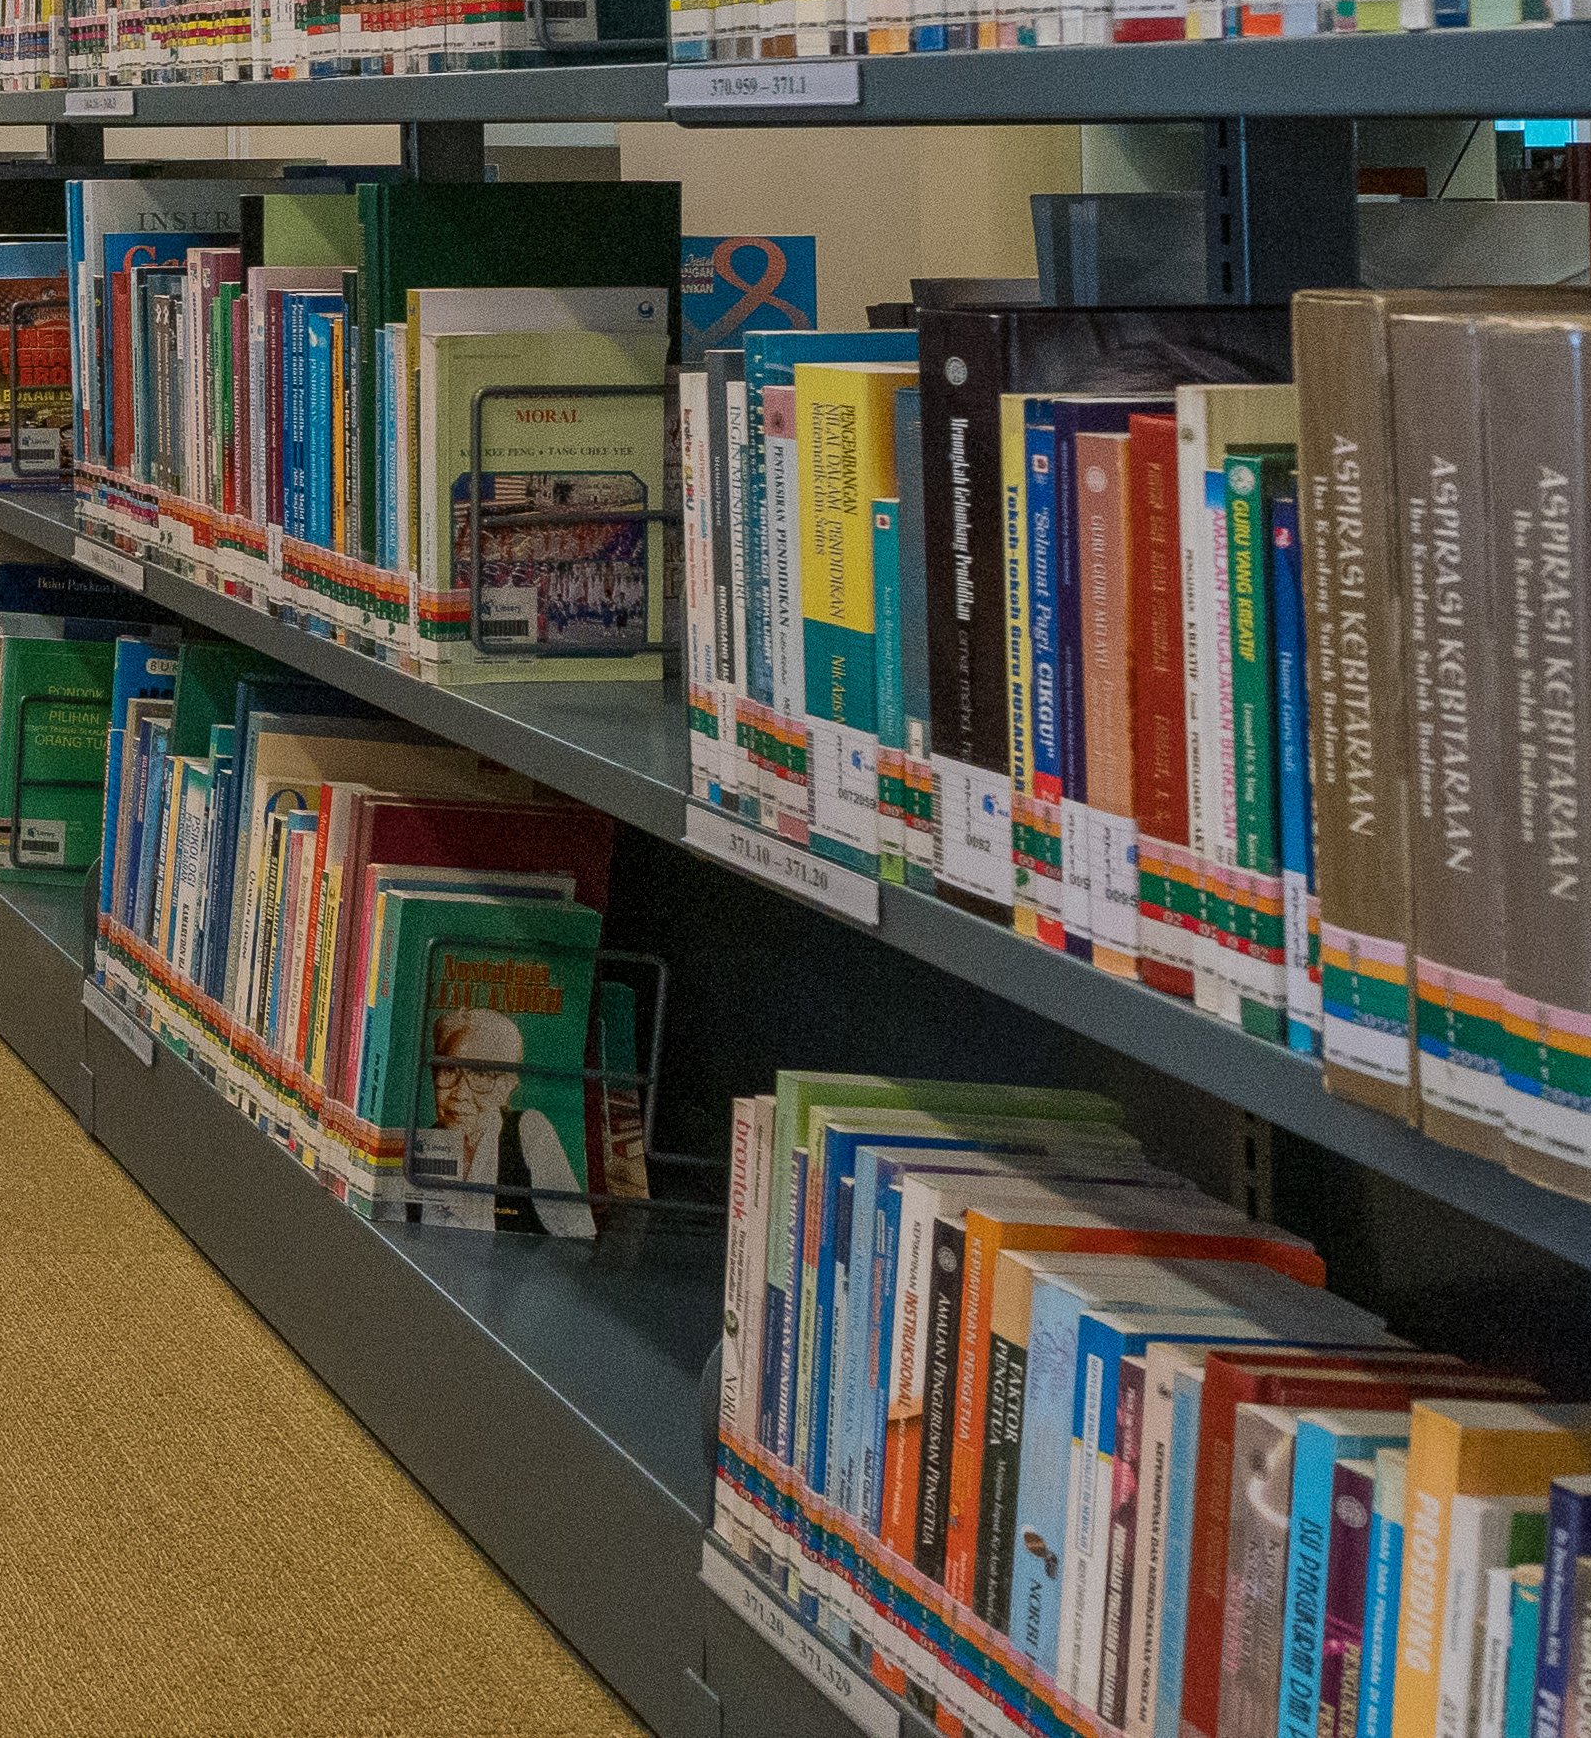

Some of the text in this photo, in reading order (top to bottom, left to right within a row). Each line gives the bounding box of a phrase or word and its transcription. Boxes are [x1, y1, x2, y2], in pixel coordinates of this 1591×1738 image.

[515, 408, 583, 425] MORAL
[1332, 434, 1365, 599] ASPIRASI
[1431, 454, 1462, 626] ASPIRASI
[1539, 465, 1571, 645] ASPIRASI
[34, 734, 81, 749] ORANG
[49, 711, 101, 725] PILIHAN
[729, 835, 772, 865] 371.10
[731, 1118, 753, 1223] brontok
